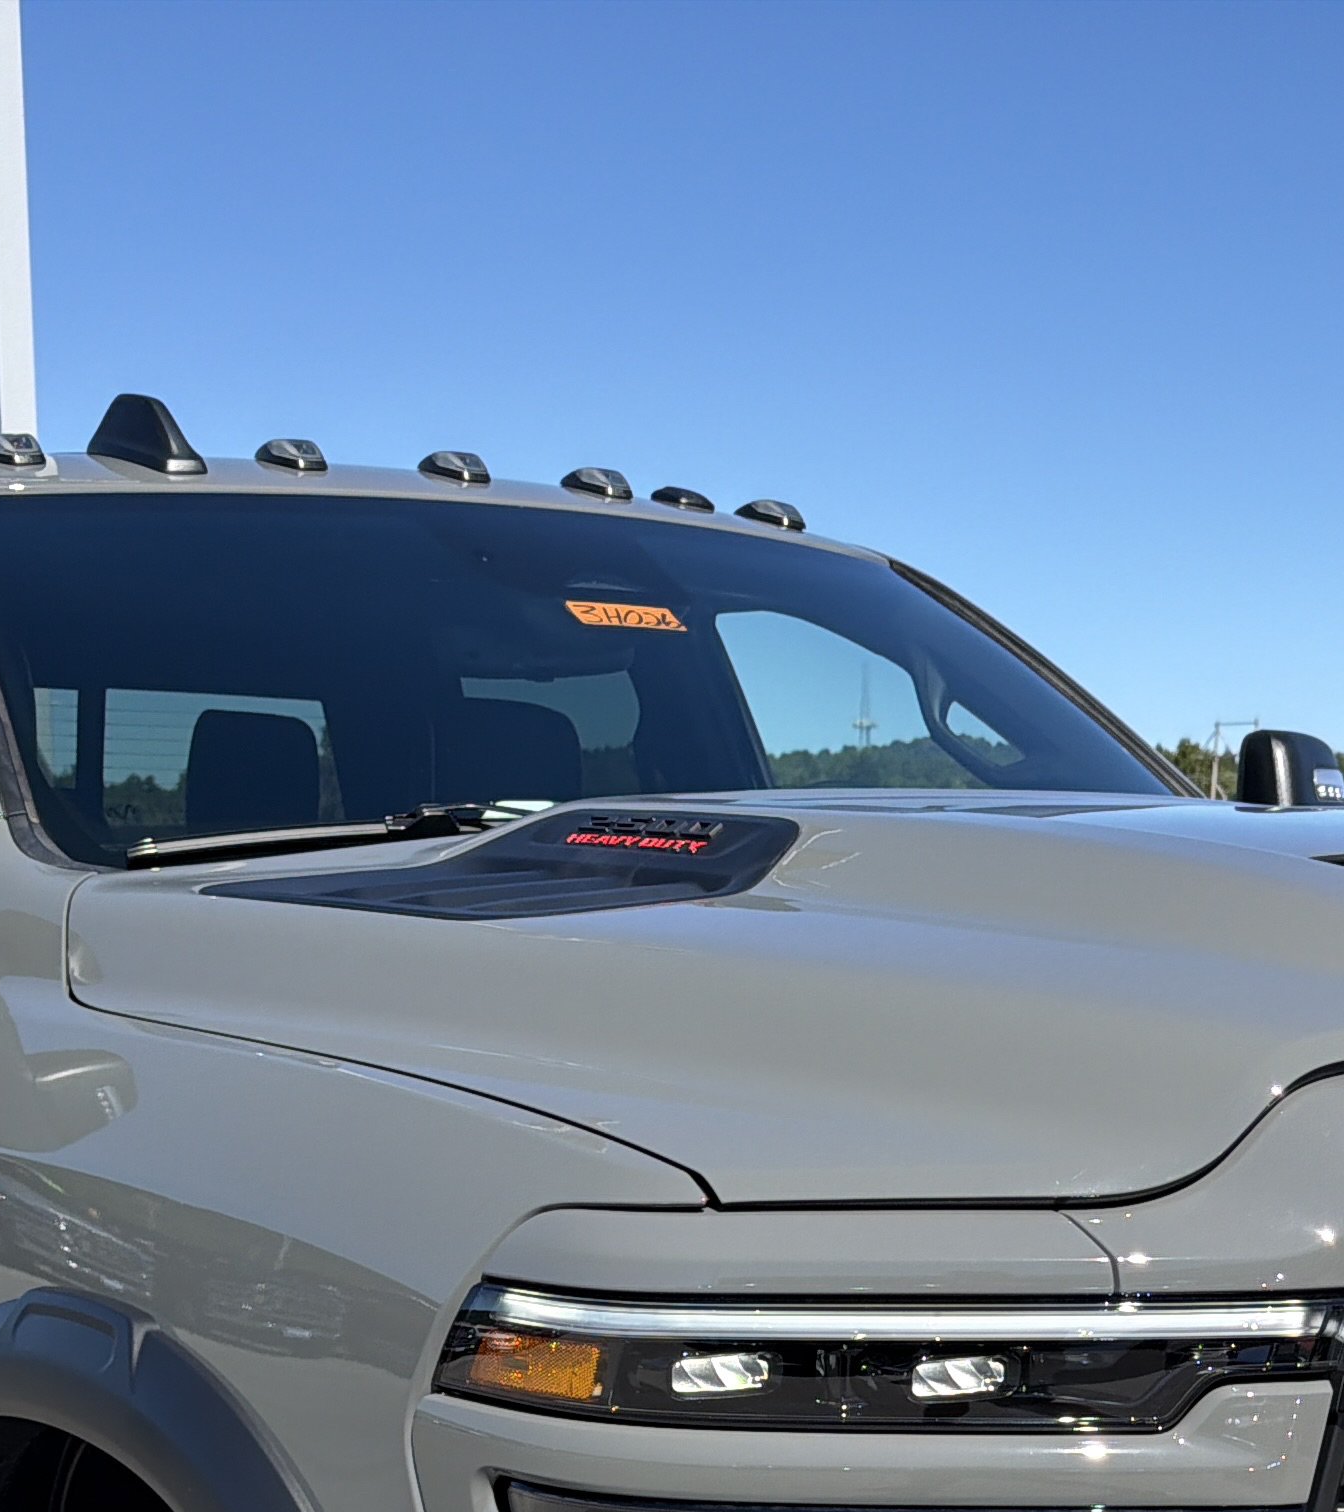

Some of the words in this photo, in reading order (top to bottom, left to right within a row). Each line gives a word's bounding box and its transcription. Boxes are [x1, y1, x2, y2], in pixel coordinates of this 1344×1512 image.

[577, 815, 724, 839] 2500
[565, 833, 641, 847] HEAVY
[638, 836, 709, 854] DUTY
